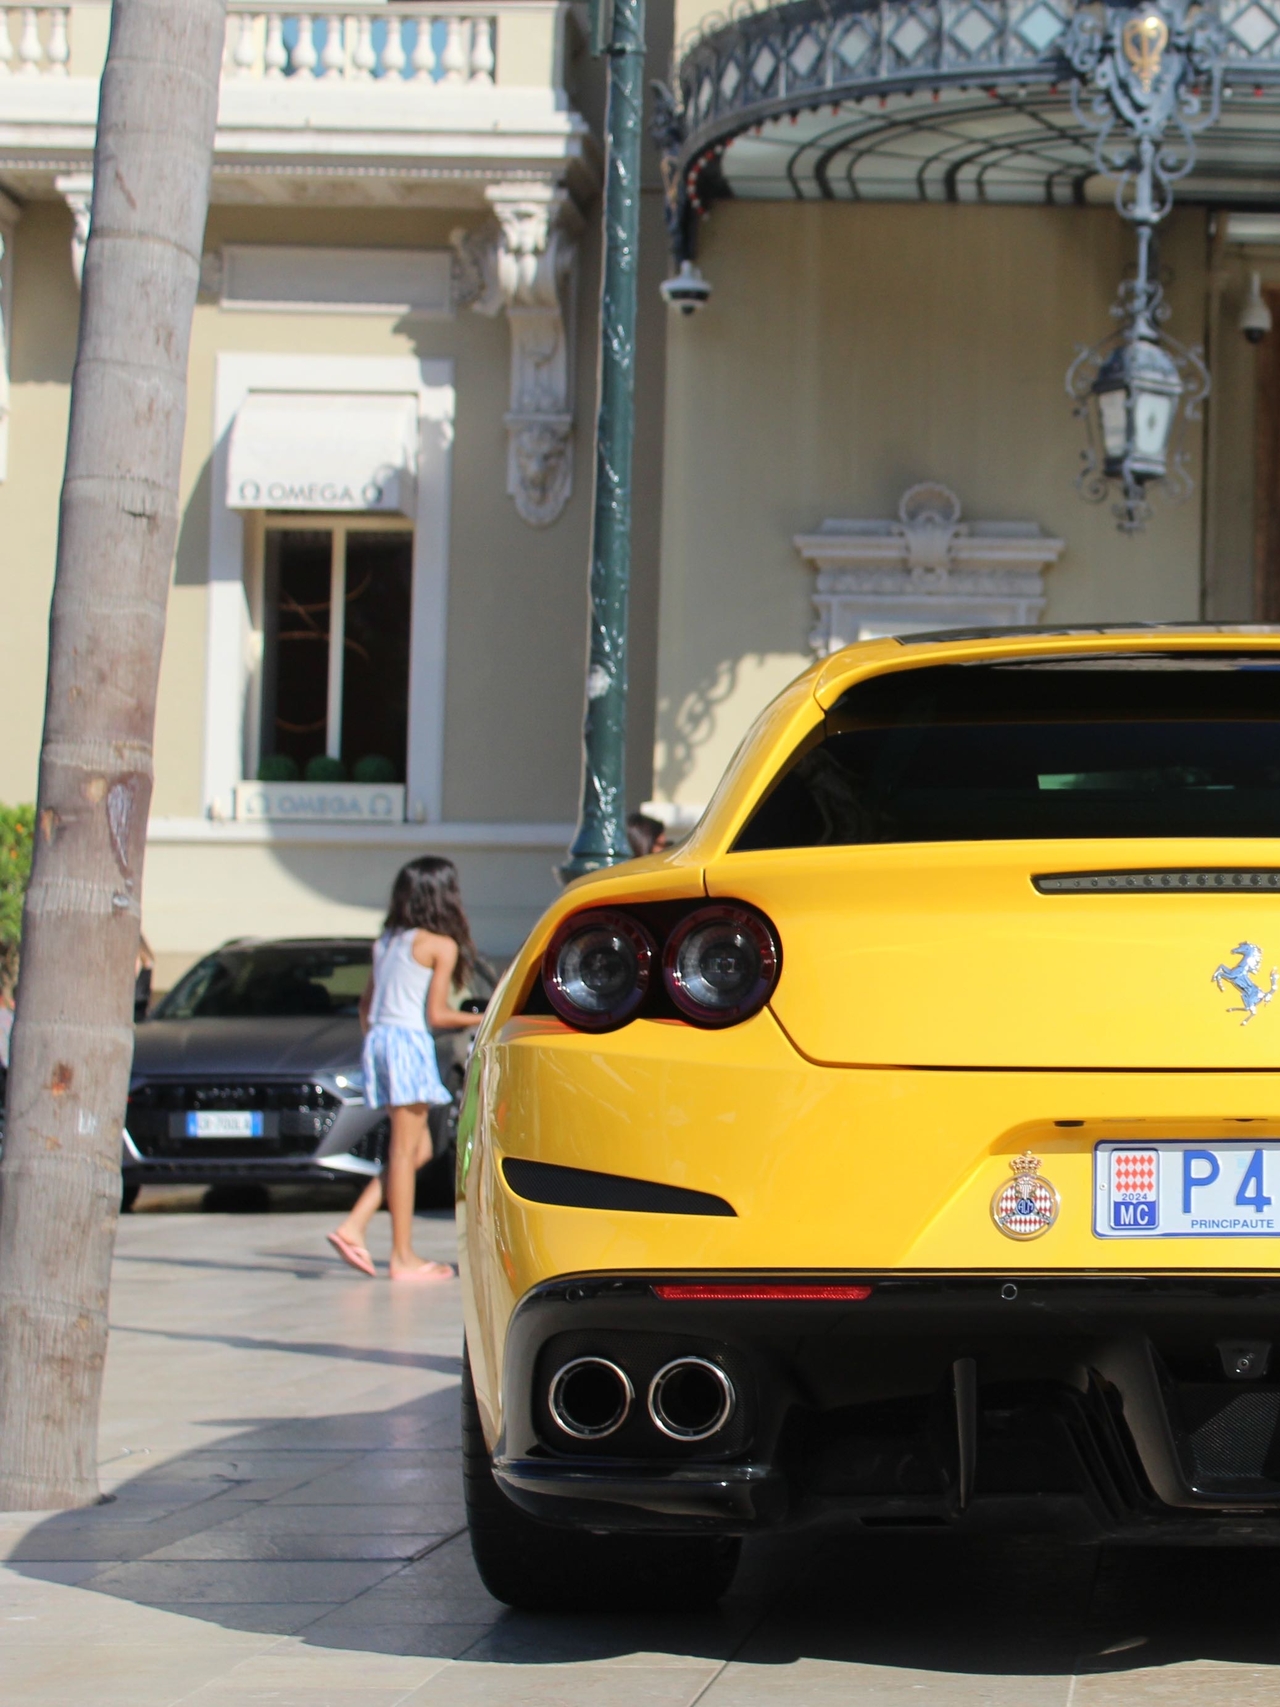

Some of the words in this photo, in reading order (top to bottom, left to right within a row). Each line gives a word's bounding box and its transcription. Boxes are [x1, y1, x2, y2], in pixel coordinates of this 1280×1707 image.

[267, 482, 354, 502] OMEGA
[277, 793, 364, 815] OMEGA
[1121, 1192, 1148, 1201] 2024
[1119, 1204, 1150, 1225] MC
[1190, 1218, 1275, 1229] PRINCIPAUTE
